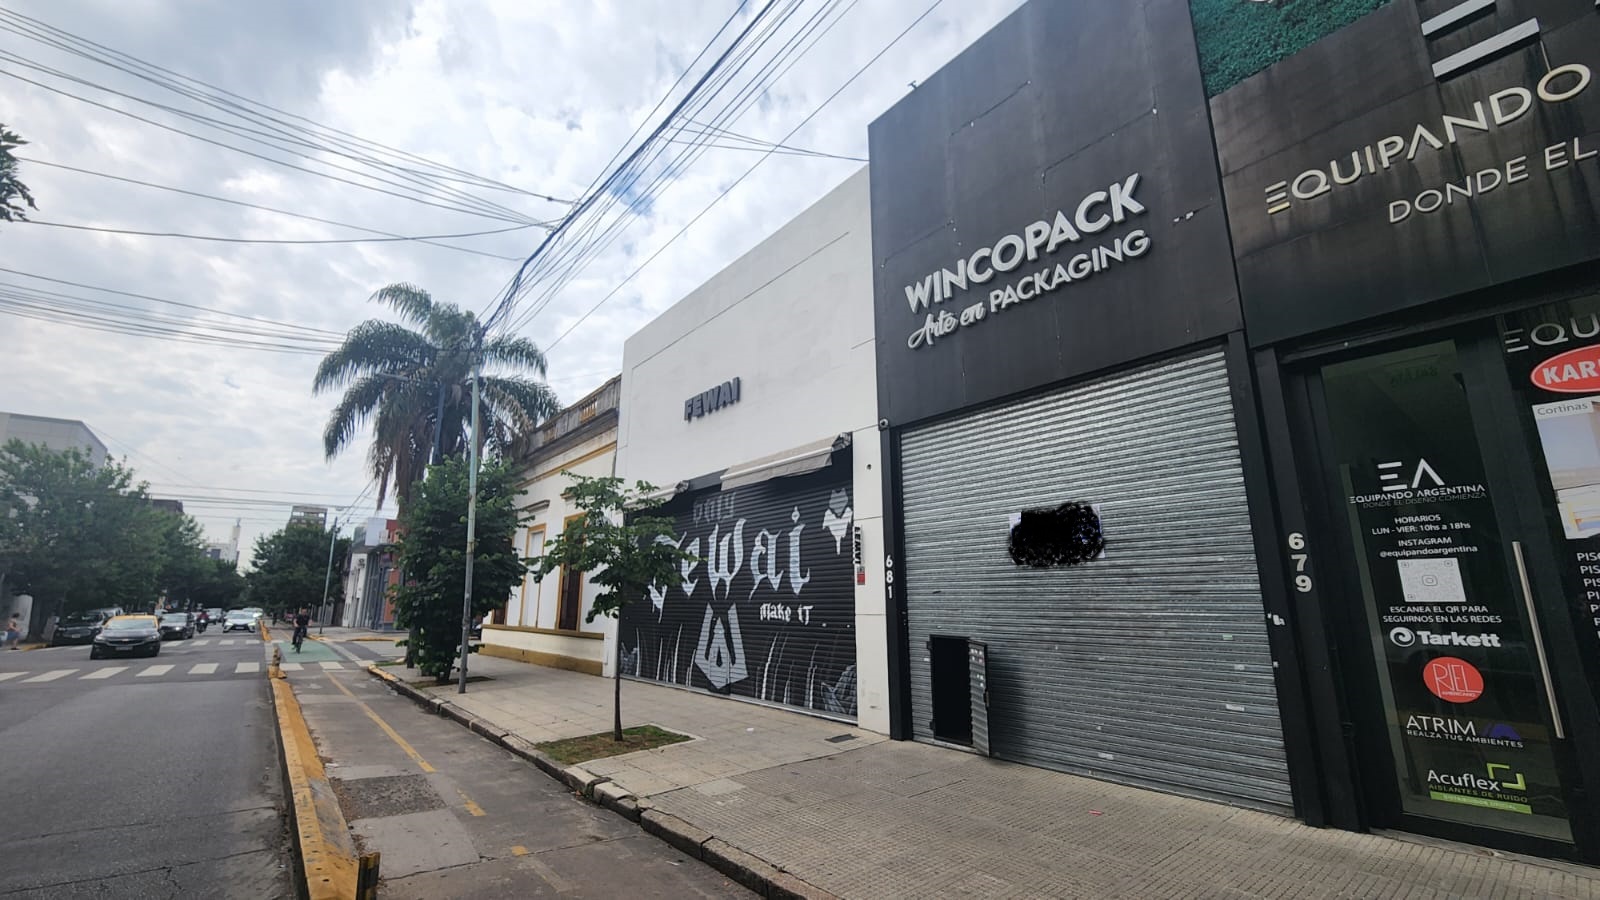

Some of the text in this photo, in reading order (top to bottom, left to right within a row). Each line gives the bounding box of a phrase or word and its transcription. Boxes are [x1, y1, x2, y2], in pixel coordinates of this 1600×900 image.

[1265, 64, 1591, 214] EQUIPANDO
[1389, 137, 1598, 223] DONDE EL
[904, 172, 1146, 313] WINCOPACK
[907, 229, 1150, 349] Arte en PACKAGING
[1543, 359, 1600, 385] KAR
[684, 376, 741, 422] FEWAI
[1536, 402, 1589, 416] Cortinas
[1349, 484, 1486, 504] EQUIPANDO ARGENTINA
[1363, 501, 1391, 509] DONDE
[1394, 499, 1404, 507] EL
[1439, 491, 1487, 502] COMIENZA
[1372, 527, 1390, 535] LUN
[1396, 525, 1418, 533] VIER:
[1420, 523, 1440, 531] 10hs
[1449, 521, 1471, 529] 18hs
[1394, 514, 1441, 524] HORARIOS
[1380, 545, 1478, 558] @equipandoargentina
[1398, 536, 1452, 547] INSTAGRAM
[1288, 532, 1312, 593] 679
[886, 554, 894, 599] 681
[1383, 615, 1502, 623] SEGUIRNOS EN LAS REDES
[1390, 605, 1431, 613] ESCANEA
[1445, 605, 1460, 613] QR
[1416, 631, 1501, 647] Tarkett
[1432, 664, 1482, 698] RIEL
[1406, 715, 1476, 736] ATRIM
[1407, 730, 1523, 748] REALZA TUS AMBIENTES
[1427, 769, 1500, 791] Acuflex
[1429, 784, 1477, 795] AISLANTES
[1481, 790, 1493, 798] DE
[1497, 793, 1527, 803] RUIDO
